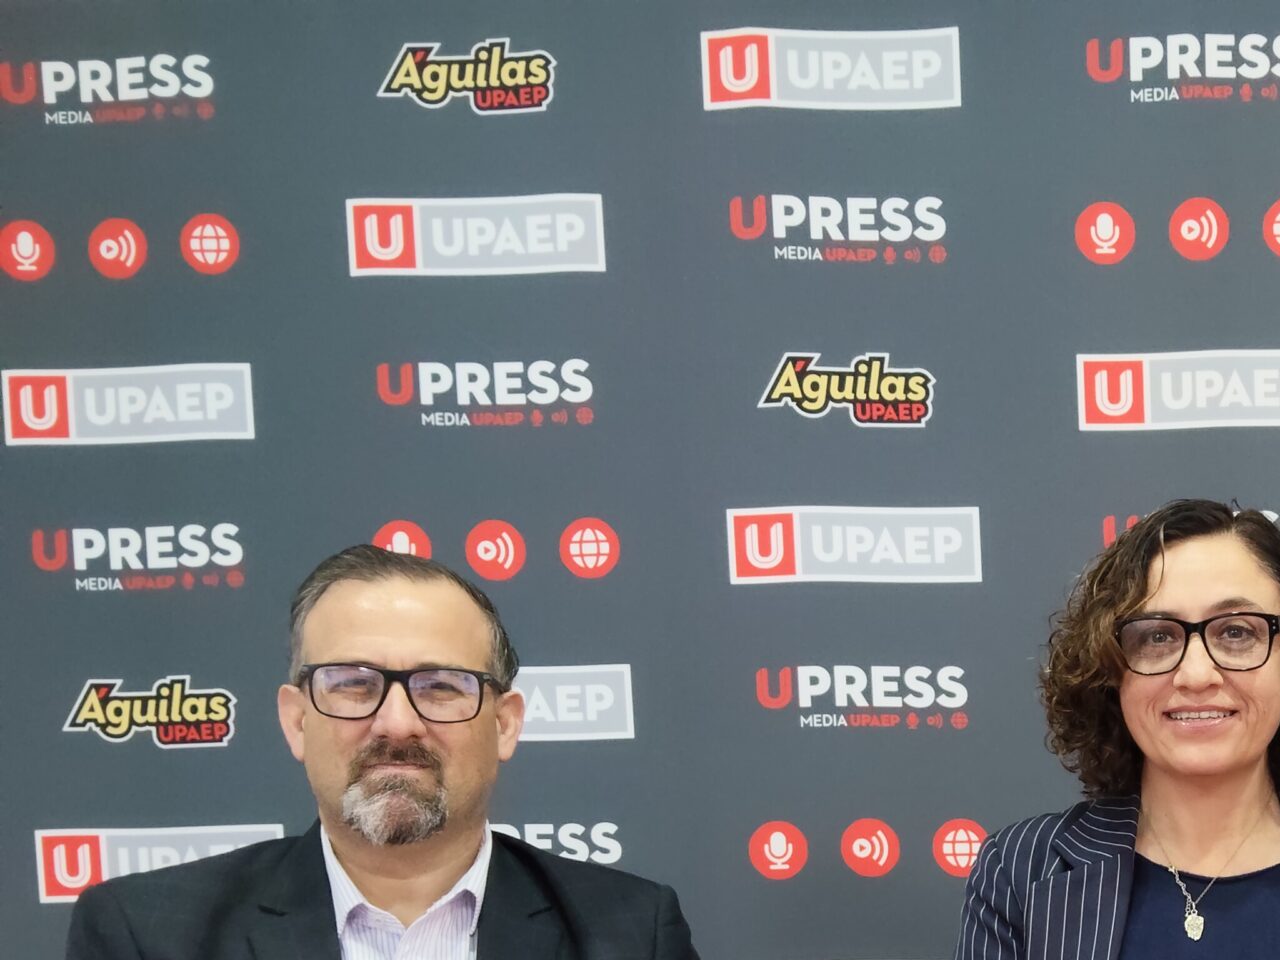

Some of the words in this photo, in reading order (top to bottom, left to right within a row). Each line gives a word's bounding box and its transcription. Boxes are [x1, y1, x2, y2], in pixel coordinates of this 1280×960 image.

[0, 54, 213, 104] UPRESS
[392, 49, 546, 100] Águilas
[787, 50, 941, 89] UPAEP
[475, 85, 547, 109] UPAEP
[1131, 87, 1179, 102] MEDIA
[1180, 85, 1232, 99] UPAEP
[45, 111, 93, 124] MEDIA
[96, 107, 145, 120] UPAEP
[432, 214, 584, 256] UPAEP
[730, 194, 946, 241] UPRESS
[774, 246, 823, 260] MEDIA
[824, 247, 877, 261] UPAEP
[378, 359, 593, 405] UPRESS
[772, 362, 925, 410] Águilas
[85, 383, 234, 425] UPAEP
[422, 412, 470, 426] MEDIA
[472, 410, 524, 425] UPAEP
[855, 400, 926, 422] UPAEP
[33, 523, 243, 570] UPRESS
[812, 526, 962, 563] UPAEP
[76, 578, 123, 590] MEDIA
[124, 576, 176, 589] UPAEP
[523, 684, 615, 722] AEP
[757, 665, 968, 708] UPRESS
[79, 685, 227, 735] Águilas
[800, 714, 847, 727] MEDIA
[849, 713, 900, 727] UPAEP
[158, 721, 228, 743] UPAEP
